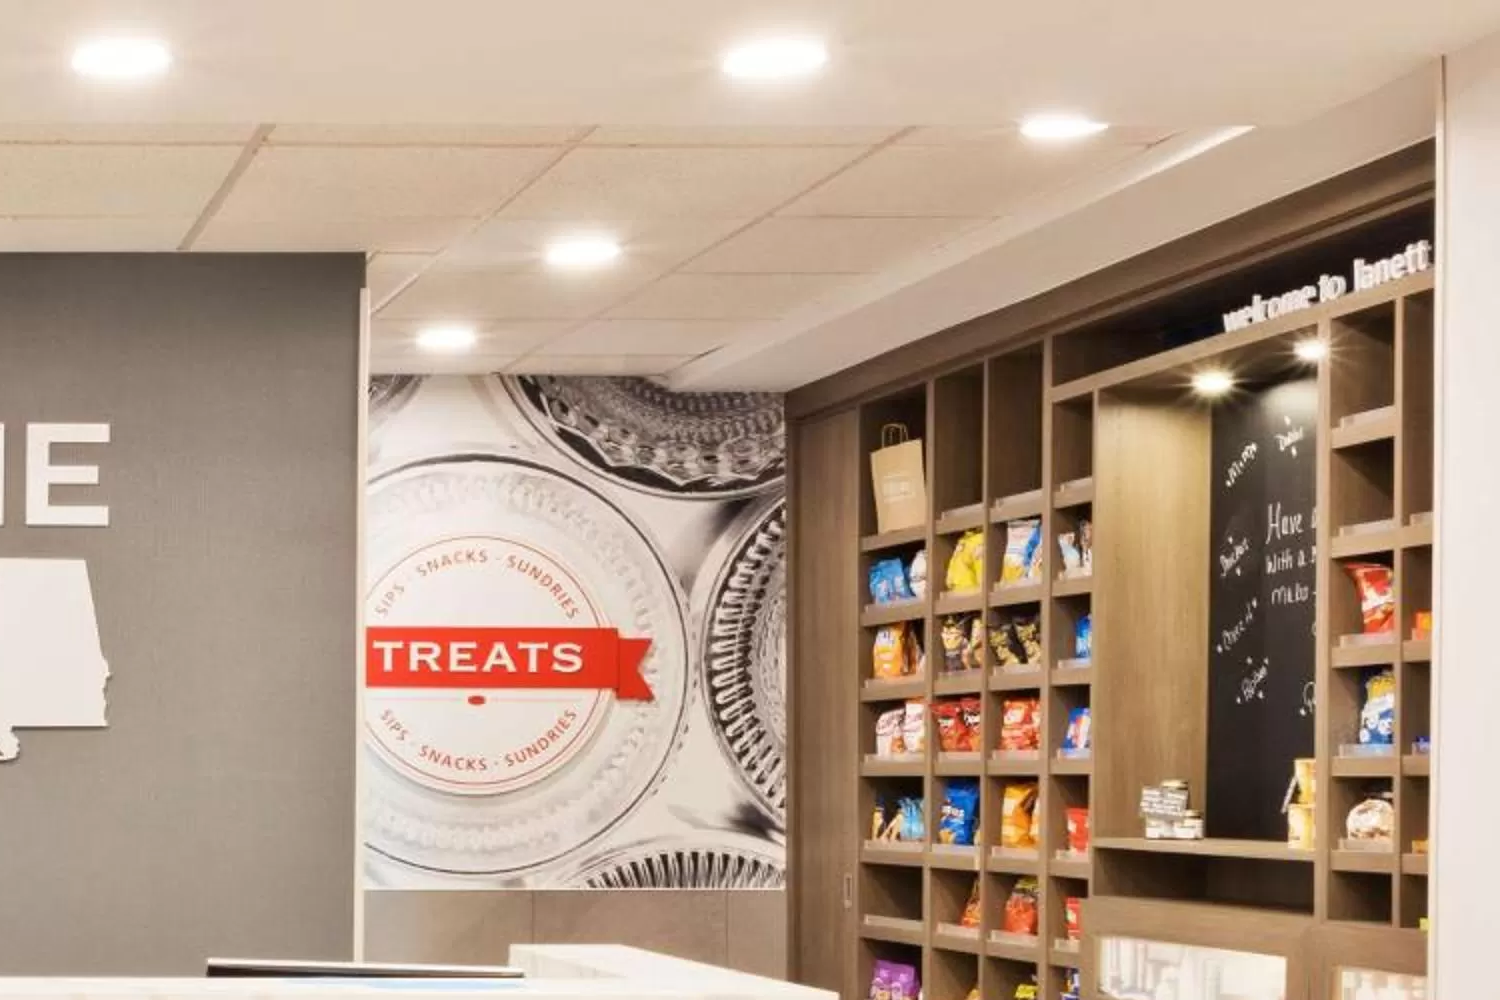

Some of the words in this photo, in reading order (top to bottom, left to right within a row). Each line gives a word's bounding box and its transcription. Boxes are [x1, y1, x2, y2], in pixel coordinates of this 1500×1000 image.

[1318, 273, 1347, 302] to
[1265, 502, 1303, 544] Have
[375, 583, 406, 617] SIPS
[415, 549, 489, 577] SNACKS
[505, 555, 580, 620] SUNDRIES
[372, 640, 584, 673] TREATS
[380, 708, 411, 741] SIPS
[419, 745, 487, 771] SNACKS
[504, 708, 577, 767] SUNDRIES
